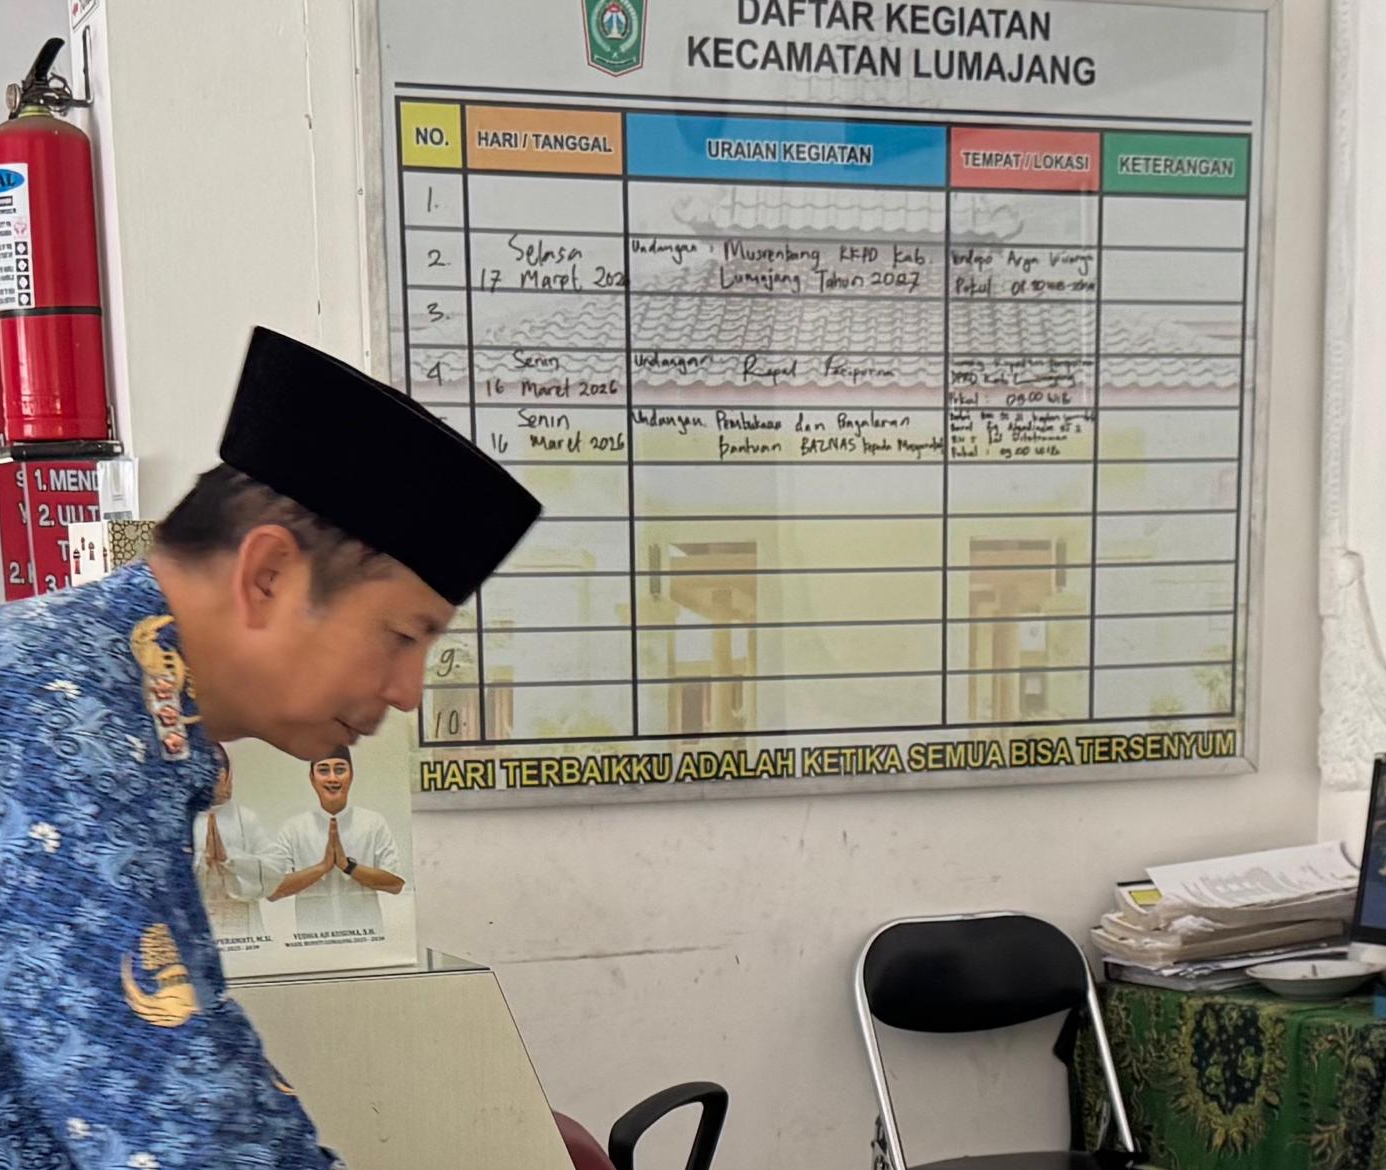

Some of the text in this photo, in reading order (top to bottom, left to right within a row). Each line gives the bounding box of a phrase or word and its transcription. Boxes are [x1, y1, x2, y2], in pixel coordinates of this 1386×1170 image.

[738, 0, 1051, 40] DAFTAR KEGIATAN
[687, 35, 1096, 86] KECAMATAN LUMAJANG
[415, 127, 449, 147] NO.
[477, 131, 518, 149] HARI
[532, 134, 613, 153] TANGGAL
[707, 140, 872, 165] URAIAN KEGIATAN
[961, 151, 1022, 170] TEMPAT
[1034, 153, 1089, 172] LOKASI
[1118, 155, 1234, 177] KETERANGAN
[480, 268, 502, 293] 17
[593, 266, 630, 288] 202
[427, 302, 451, 322] 3.
[38, 504, 55, 527] 2.
[421, 731, 1236, 791] HARI TERBAIKKU ADALAH KETIKA SEMUA BISA TERSENYUM
